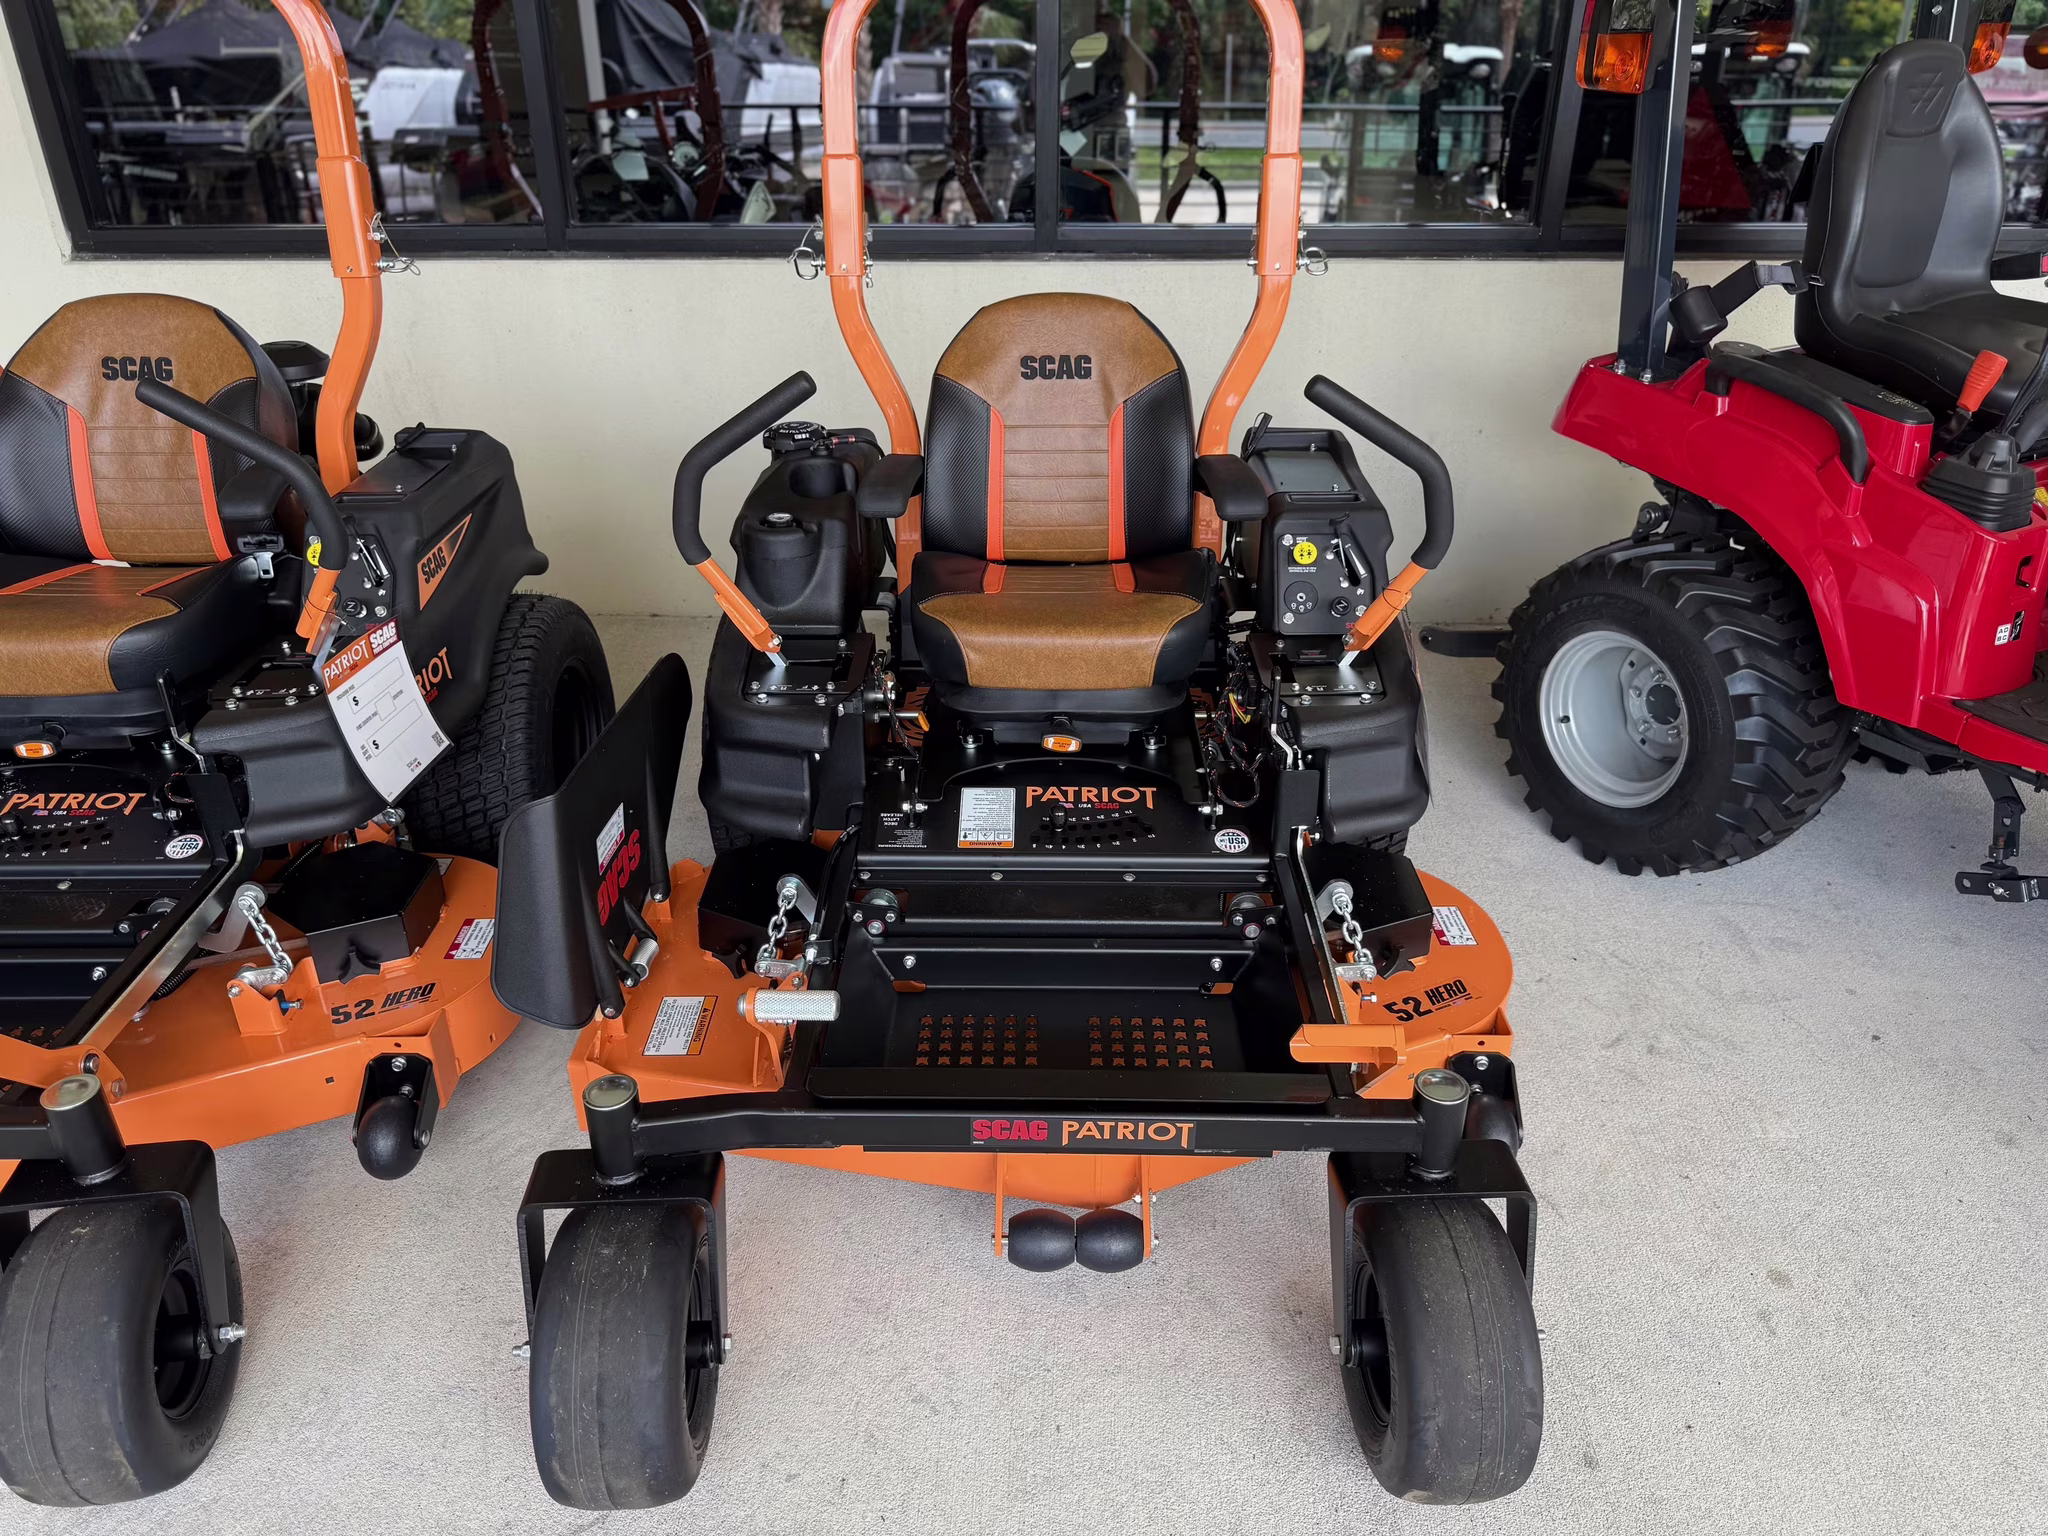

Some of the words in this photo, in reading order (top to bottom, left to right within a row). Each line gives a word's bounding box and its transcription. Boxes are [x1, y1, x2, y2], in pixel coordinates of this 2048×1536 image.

[101, 356, 174, 381] SCAG
[1020, 355, 1092, 380] SCAG
[421, 546, 447, 584] SCAG
[369, 622, 397, 649] SCAG
[324, 640, 369, 689] PATRIOT
[415, 647, 452, 696] RIOT
[0, 793, 146, 816] PATRIOT
[1026, 786, 1157, 810] PATRIOT
[180, 842, 200, 850] USA
[598, 829, 640, 926] SCAG
[454, 926, 471, 944] DANGER
[331, 998, 376, 1024] 52
[381, 982, 436, 1009] HERO
[1382, 996, 1434, 1022] 52
[1424, 980, 1468, 1006] HERO
[694, 1013, 708, 1042] WARNING
[972, 1119, 1048, 1141] SCAG
[1062, 1120, 1194, 1149] PATRIOT
